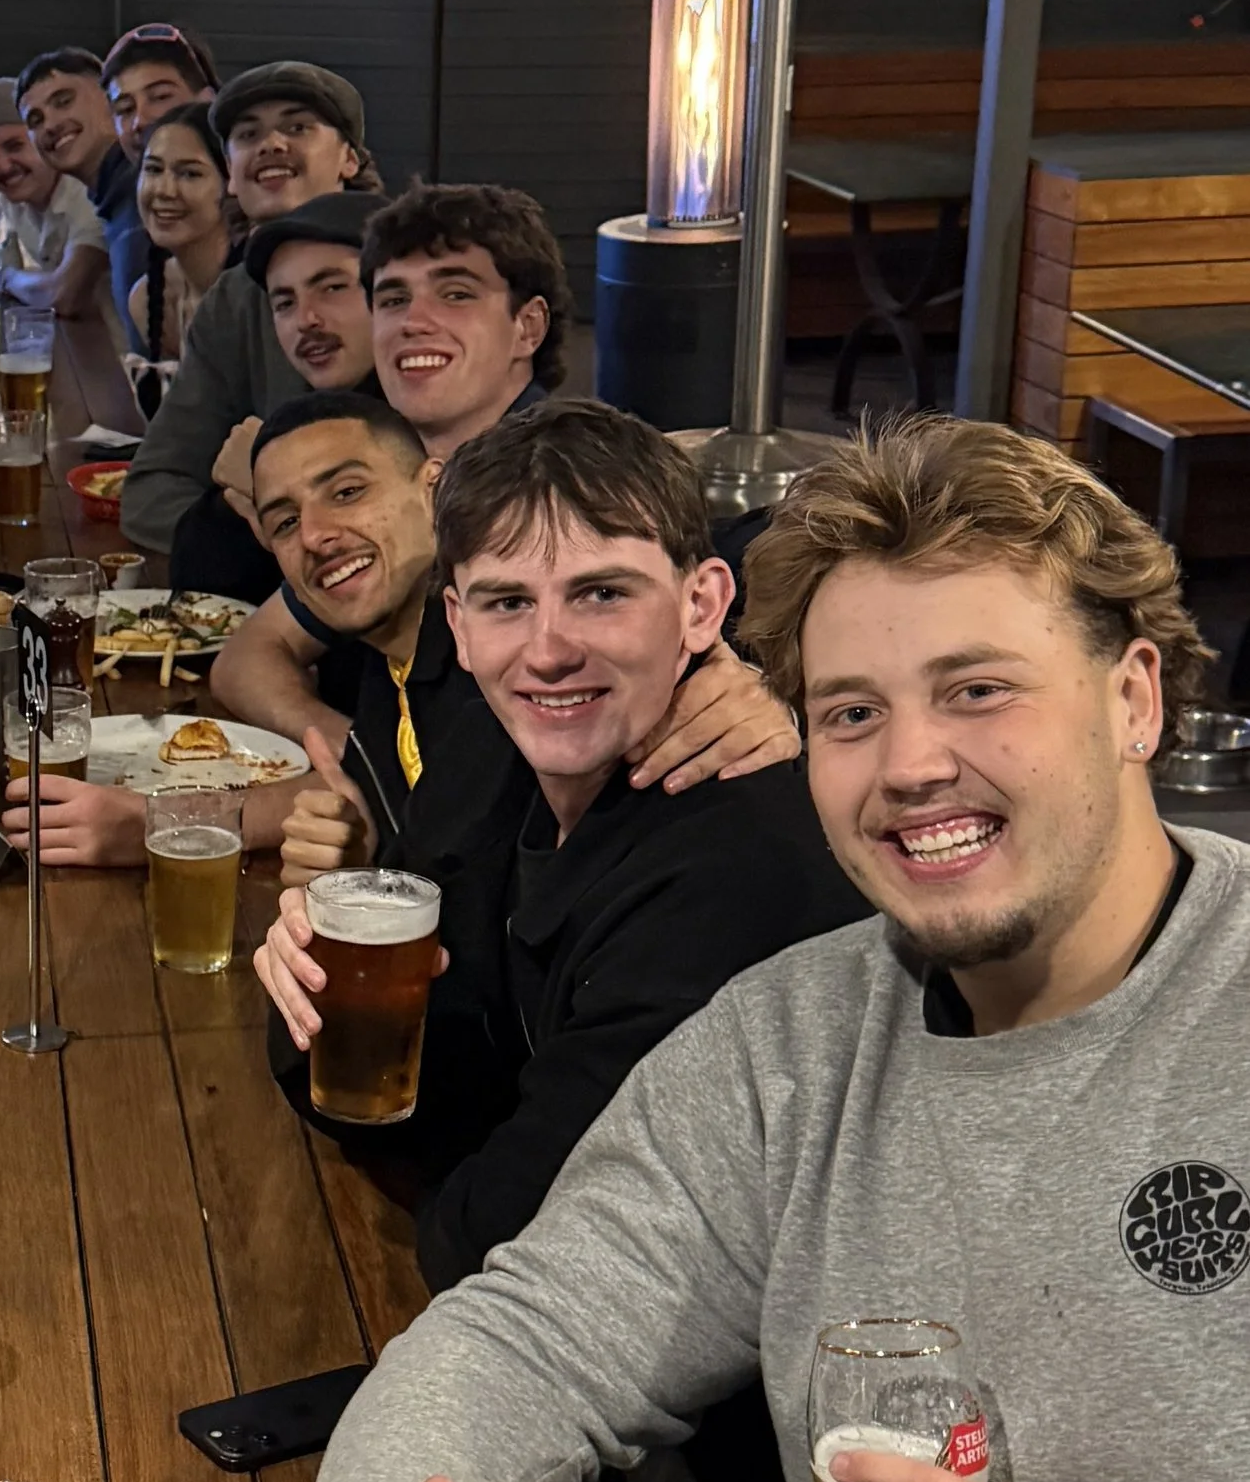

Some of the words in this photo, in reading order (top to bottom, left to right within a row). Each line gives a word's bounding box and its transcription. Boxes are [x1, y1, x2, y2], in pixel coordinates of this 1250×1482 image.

[23, 626, 48, 715] 33
[1126, 1191, 1250, 1251] CURL
[1127, 1164, 1225, 1218] RIP
